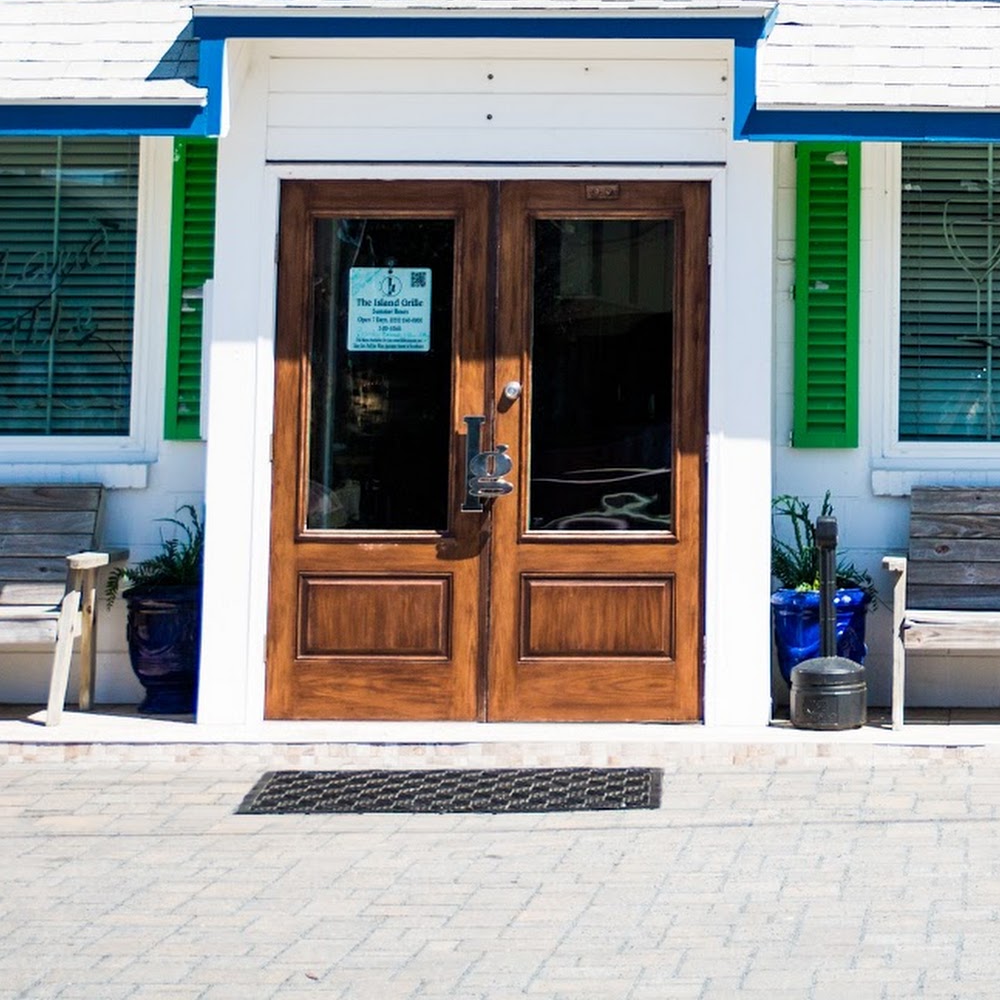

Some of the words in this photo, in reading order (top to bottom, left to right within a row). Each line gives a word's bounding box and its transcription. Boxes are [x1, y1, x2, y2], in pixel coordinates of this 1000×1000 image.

[357, 298, 372, 307] The
[374, 298, 400, 307] Island
[401, 298, 424, 307] Grille
